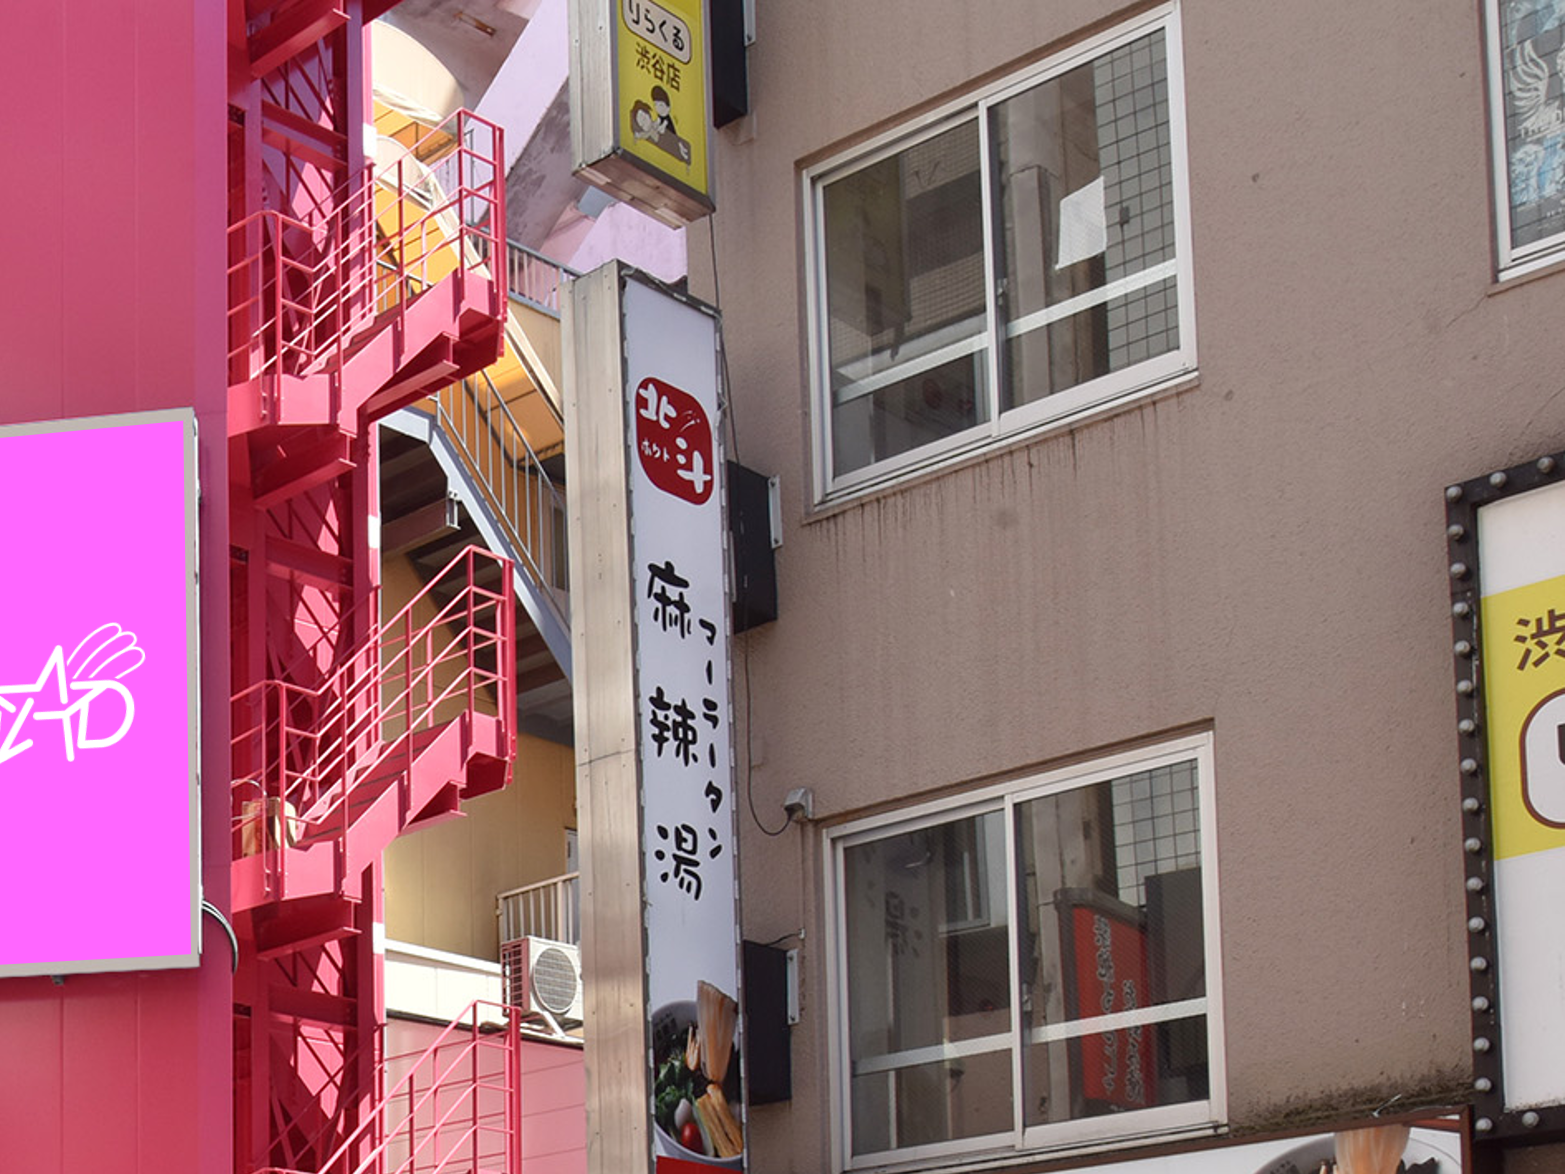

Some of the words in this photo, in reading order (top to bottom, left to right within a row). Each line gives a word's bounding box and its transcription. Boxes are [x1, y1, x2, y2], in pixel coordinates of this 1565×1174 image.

[636, 42, 681, 92] 渋谷店
[641, 438, 670, 463] ホクト
[647, 560, 702, 902] 麻辣湯
[699, 617, 724, 859] マーラータン
